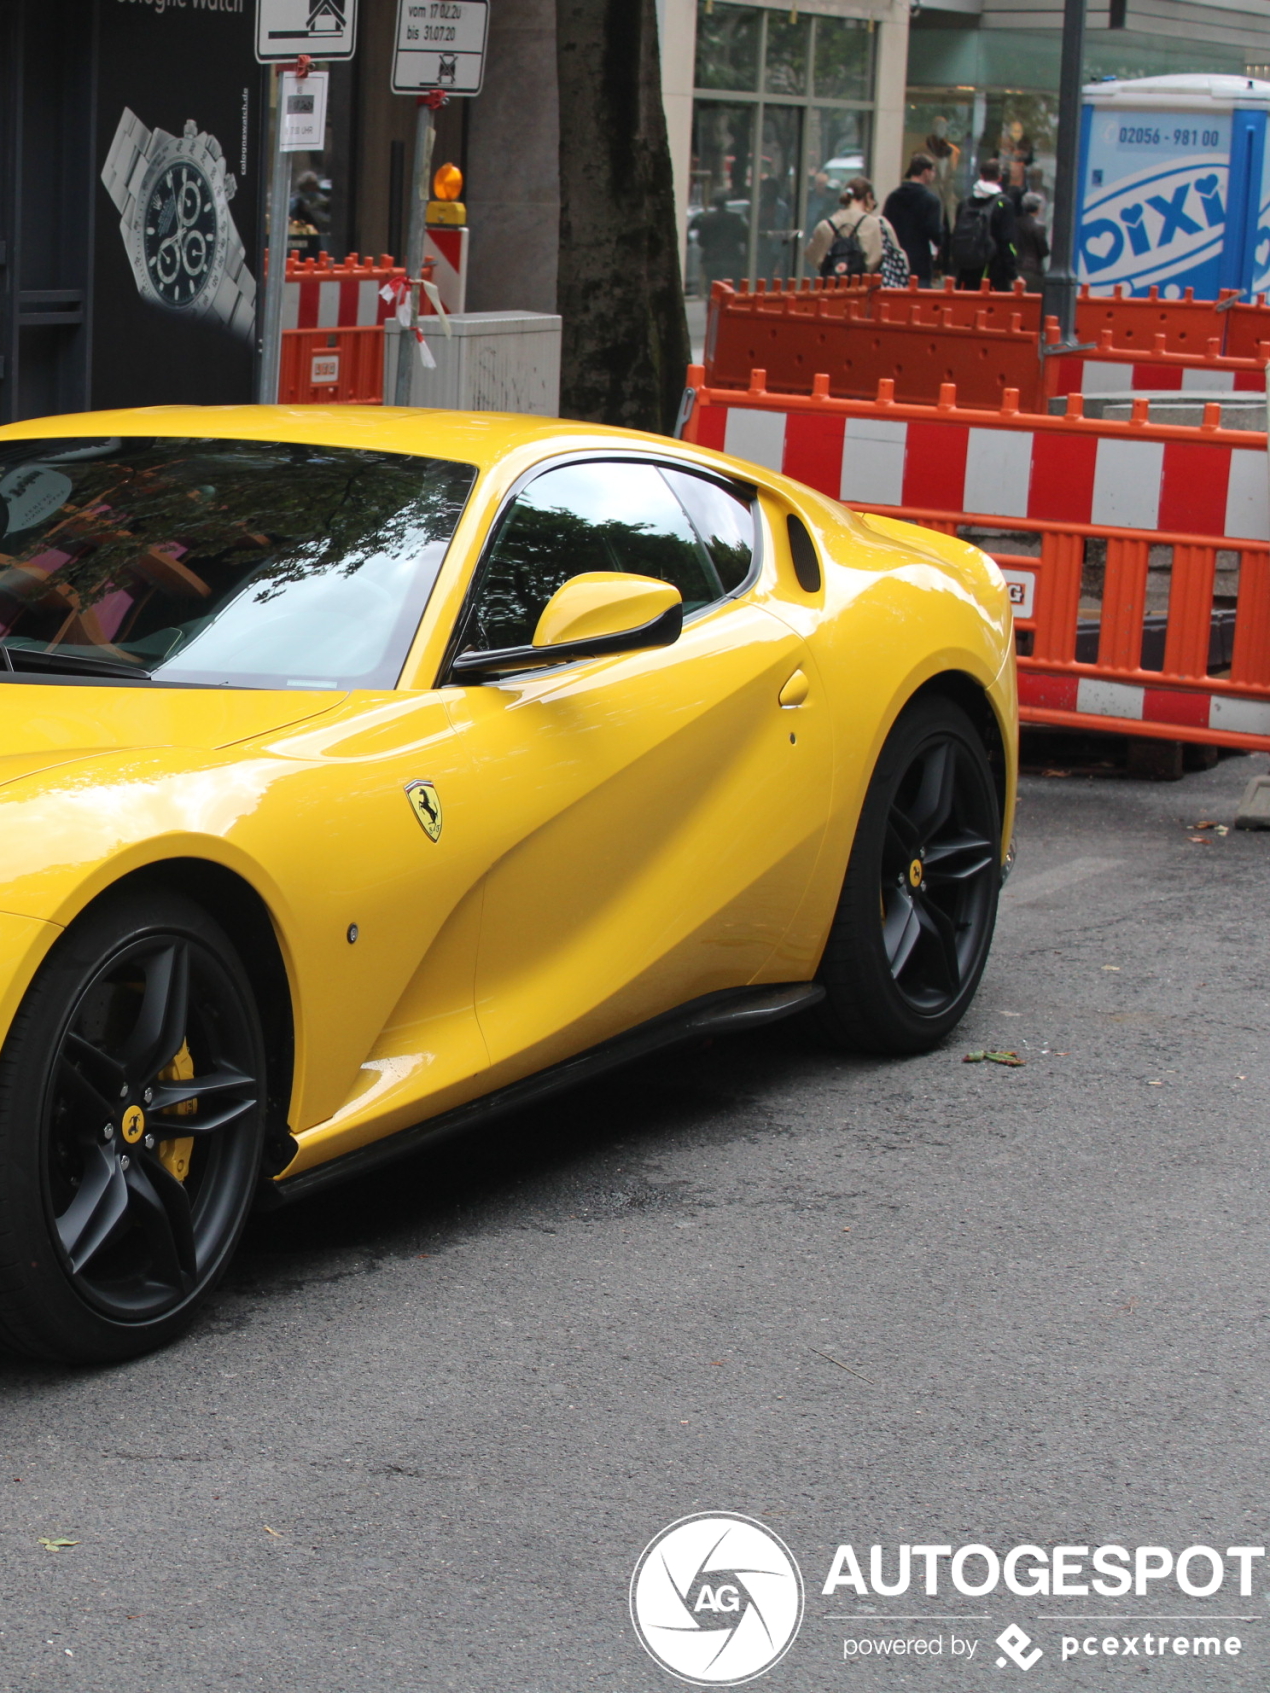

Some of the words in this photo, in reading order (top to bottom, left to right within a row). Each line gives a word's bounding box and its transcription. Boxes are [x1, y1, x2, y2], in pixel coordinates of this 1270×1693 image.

[408, 6, 426, 18] vom
[407, 25, 419, 40] bis
[240, 87, 248, 176] colognewatch.de
[1119, 127, 1160, 145] 02056
[1174, 129, 1197, 146] 981
[1202, 130, 1220, 147] 00
